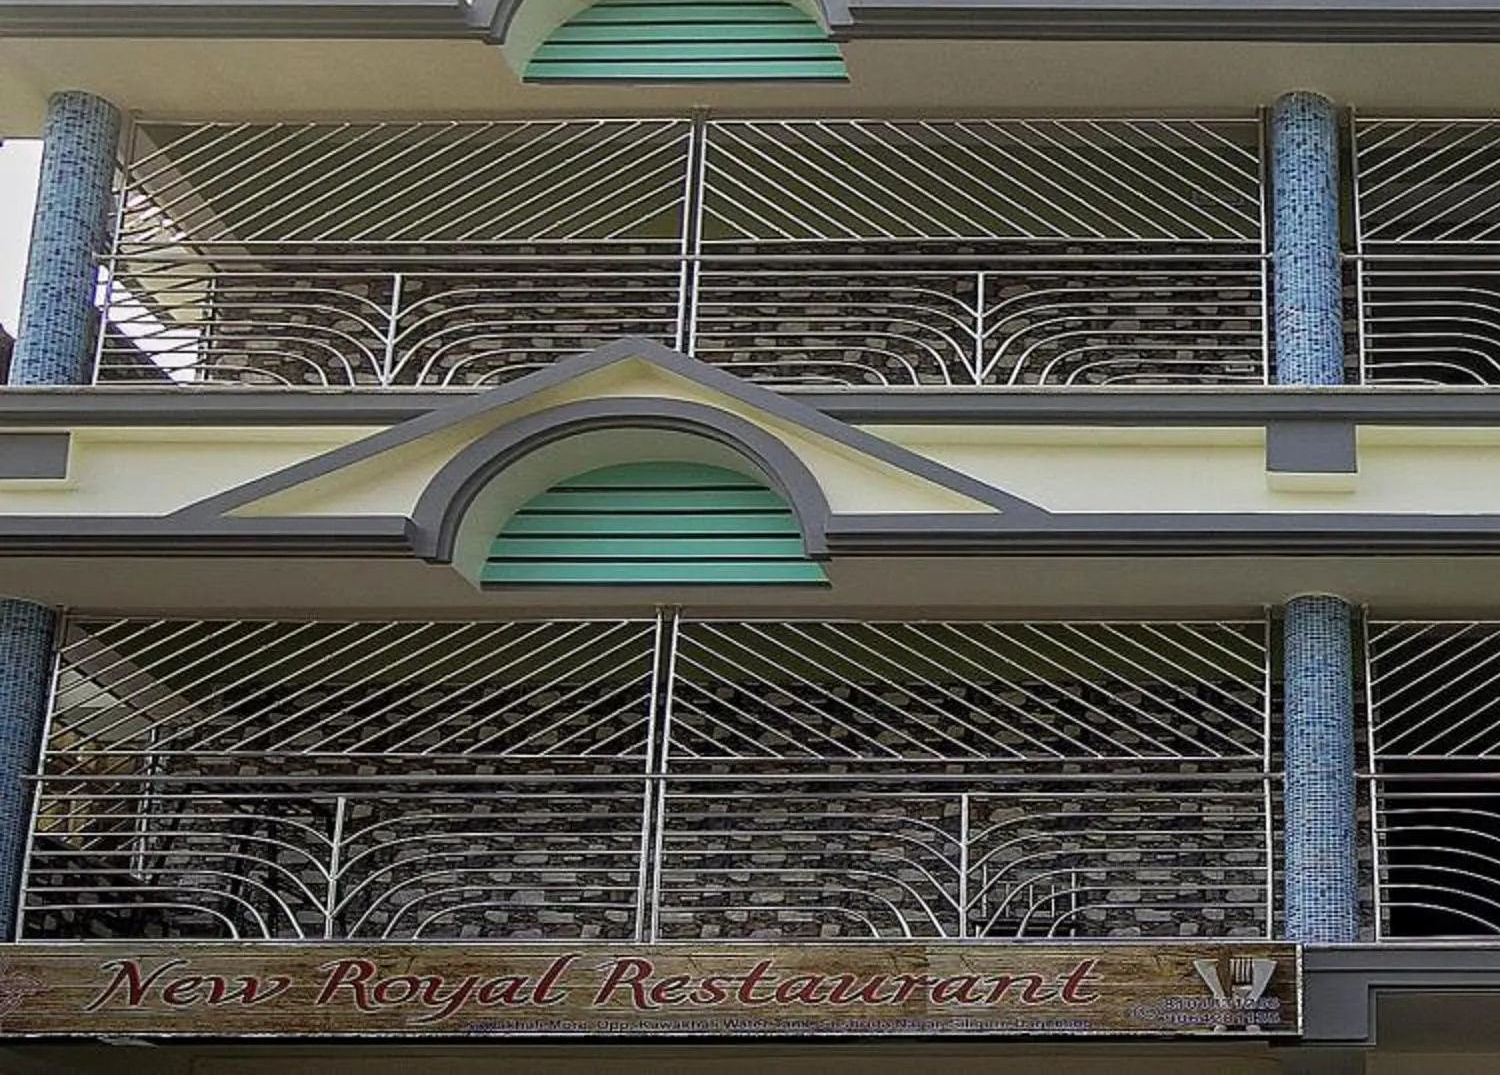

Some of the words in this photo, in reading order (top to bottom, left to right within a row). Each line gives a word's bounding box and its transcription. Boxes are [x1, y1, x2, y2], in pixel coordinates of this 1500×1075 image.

[84, 958, 293, 1013] New
[314, 952, 583, 1025] Royal
[592, 957, 1104, 1013] Restaurant
